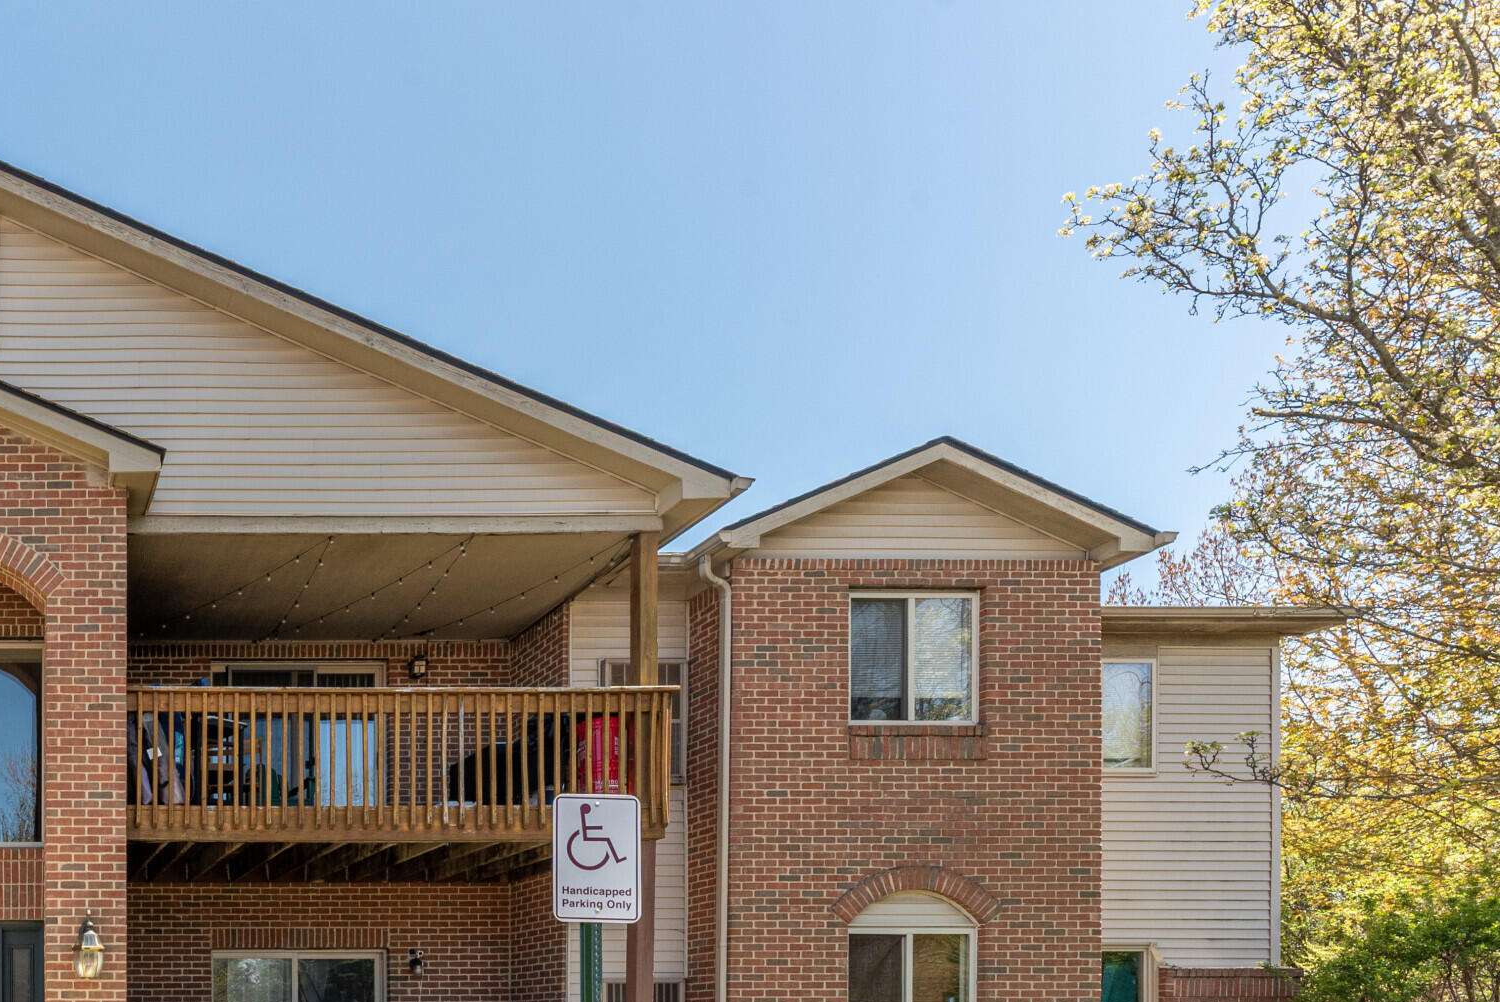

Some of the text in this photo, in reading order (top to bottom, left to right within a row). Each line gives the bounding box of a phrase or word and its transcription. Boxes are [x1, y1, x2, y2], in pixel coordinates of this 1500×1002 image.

[562, 886, 632, 898] Handicapped
[562, 899, 632, 911] Parking Only
